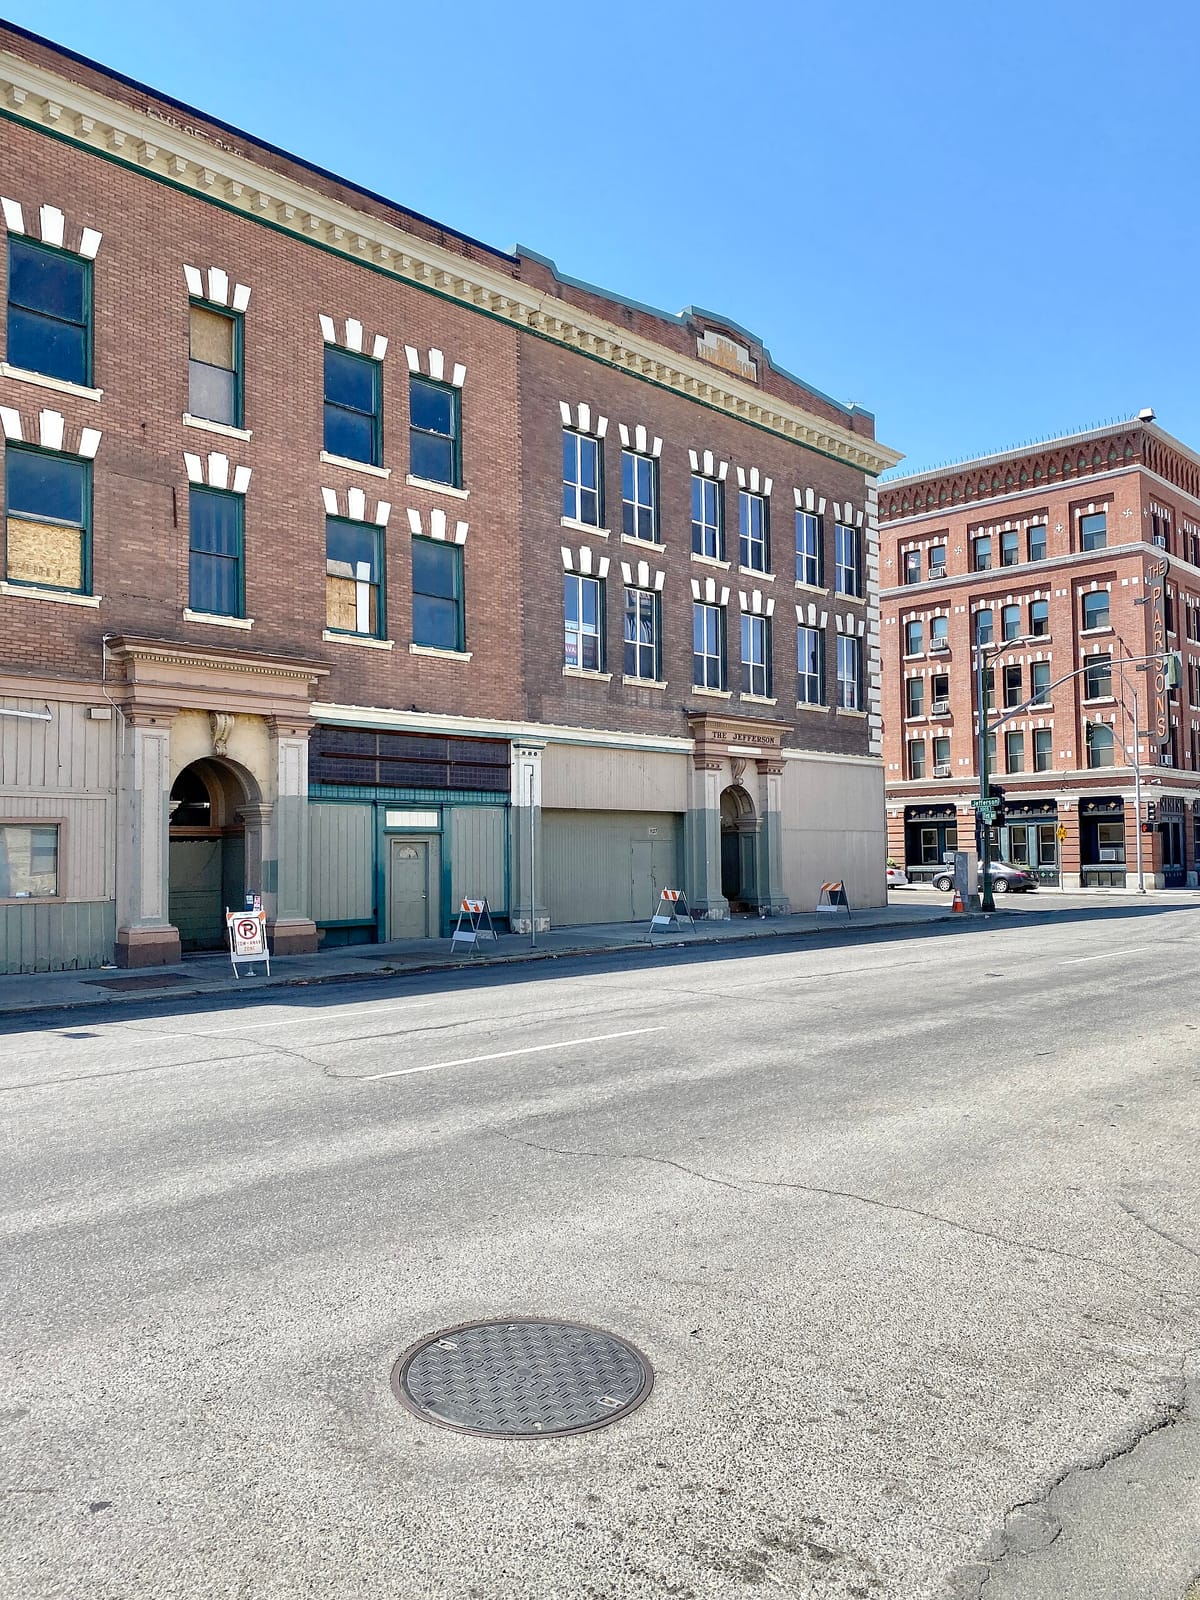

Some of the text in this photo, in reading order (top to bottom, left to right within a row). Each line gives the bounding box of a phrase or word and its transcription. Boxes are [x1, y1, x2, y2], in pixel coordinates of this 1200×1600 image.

[1147, 560, 1166, 737] THE PARSONS
[712, 731, 775, 744] THE JEFFERSON
[972, 799, 998, 807] Jefferson
